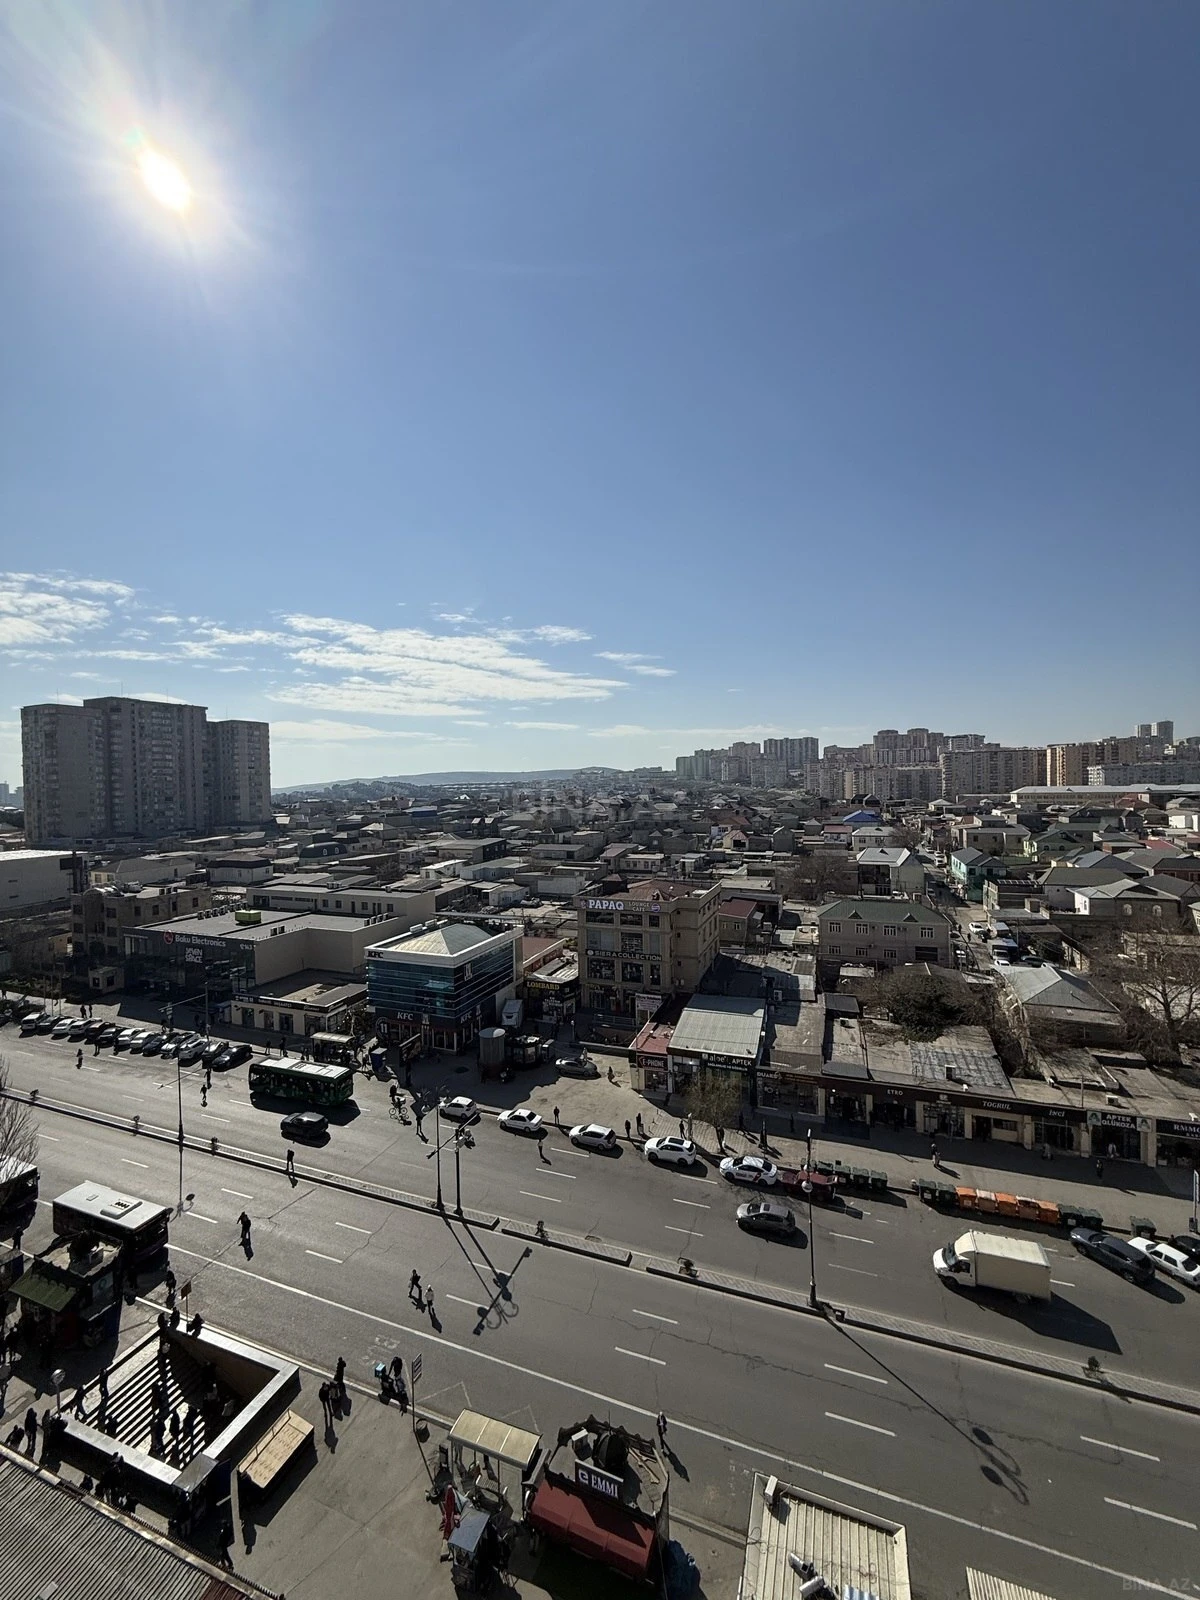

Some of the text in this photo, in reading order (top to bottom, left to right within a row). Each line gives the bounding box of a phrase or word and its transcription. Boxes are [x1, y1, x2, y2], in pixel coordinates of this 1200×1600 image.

[589, 899, 624, 910] PAPAQ
[192, 936, 227, 948] Electronics
[368, 950, 384, 959] KFC
[618, 952, 662, 961] COLLECTION
[526, 981, 560, 991] LOMBARD
[397, 1011, 414, 1021] KFC
[461, 1010, 472, 1024] KFC
[732, 1057, 752, 1067] APTEK
[1106, 1113, 1131, 1122] APTEK
[591, 1474, 618, 1499] EMMI
